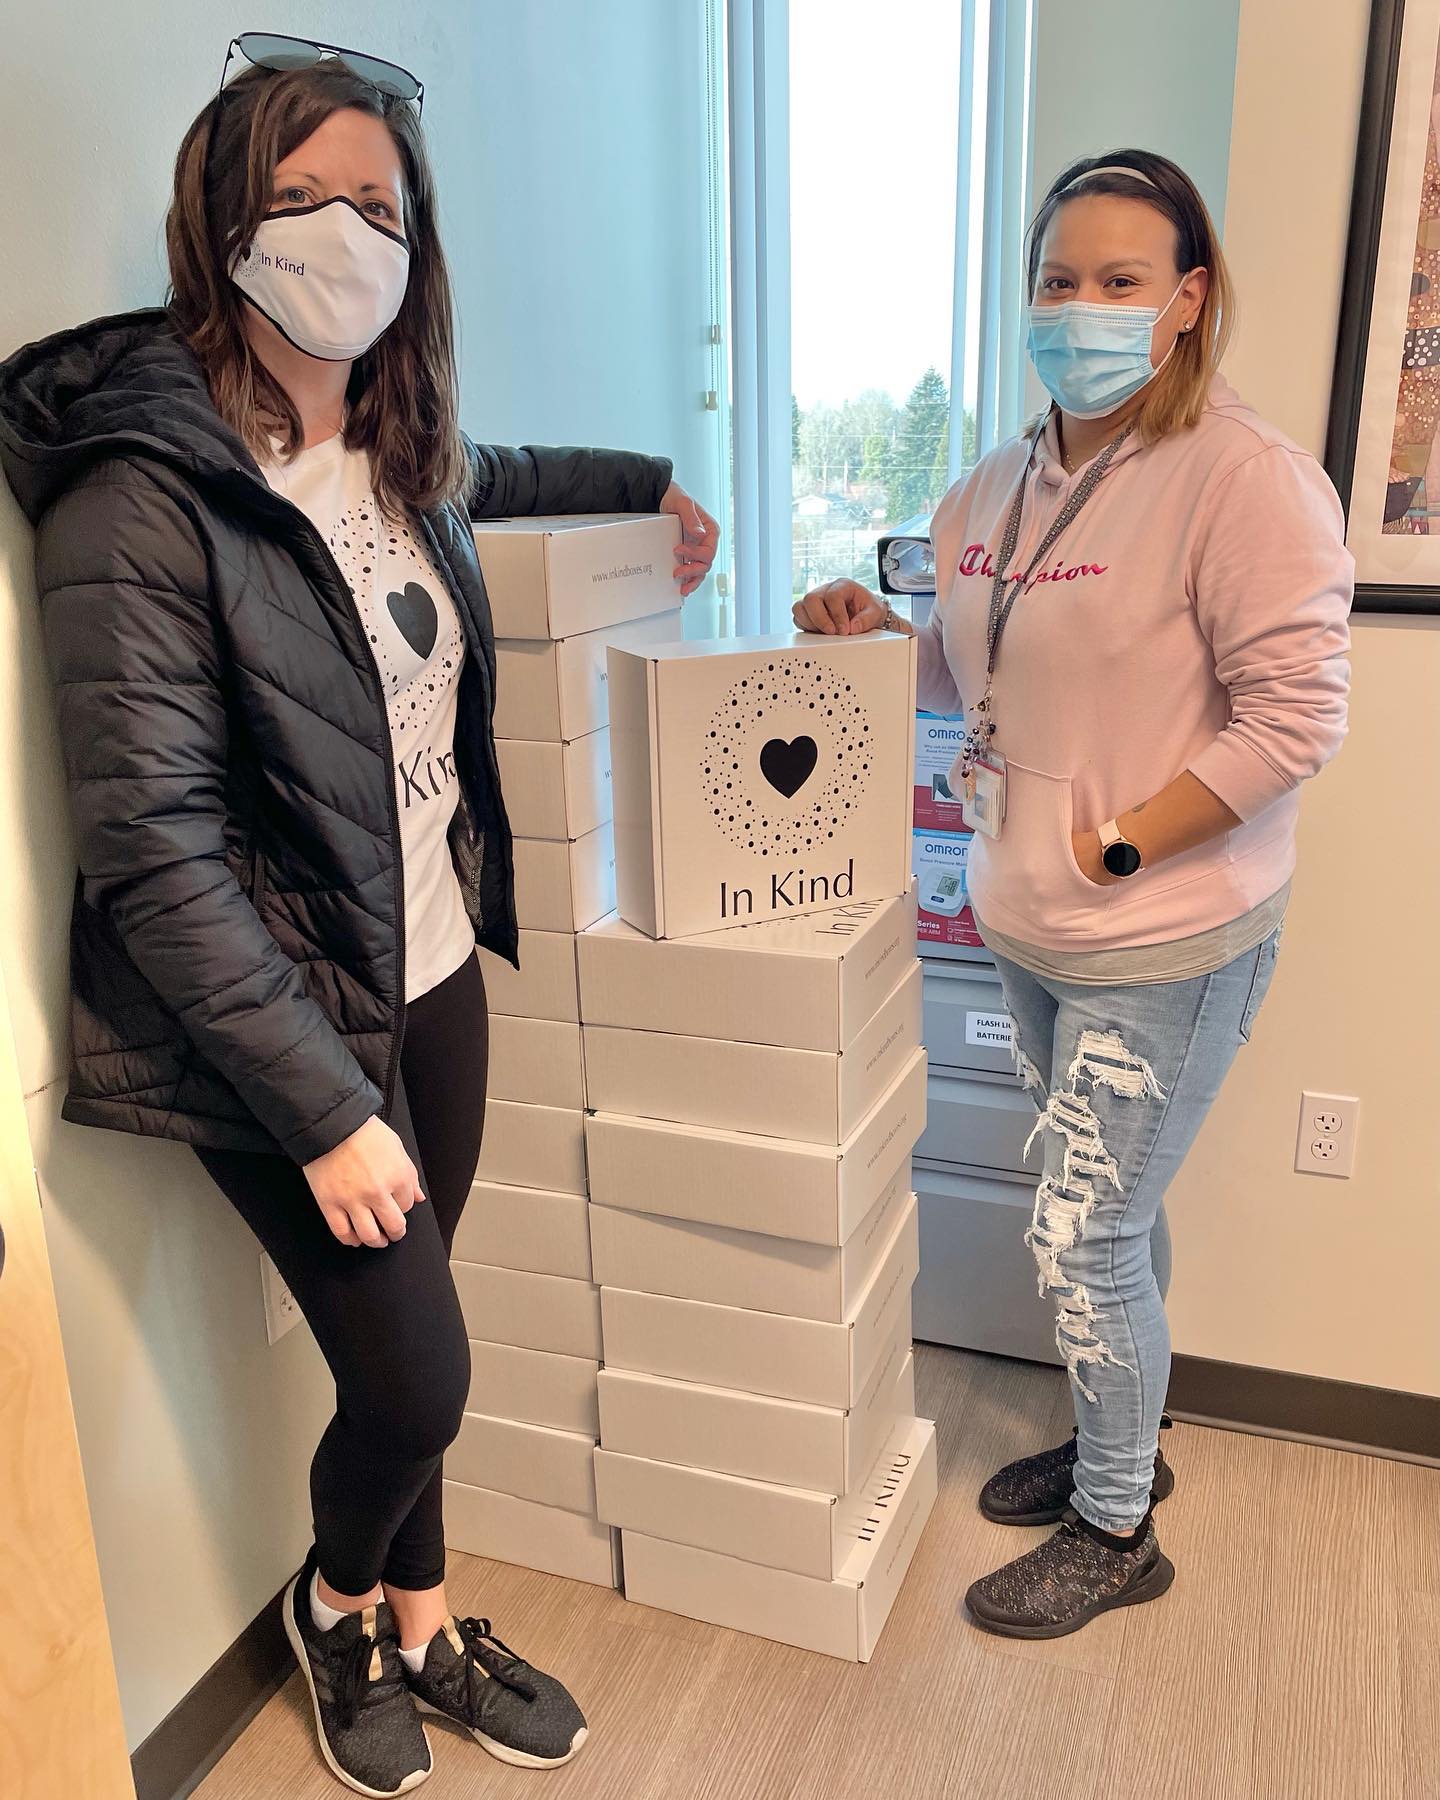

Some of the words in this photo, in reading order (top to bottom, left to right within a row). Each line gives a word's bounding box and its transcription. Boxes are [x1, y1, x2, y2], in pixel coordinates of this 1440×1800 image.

[261, 252, 271, 267] In
[275, 256, 305, 276] Kind
[959, 543, 1109, 595] Chmpion
[928, 728, 966, 741] OMRO
[398, 745, 456, 809] Kin
[720, 881, 753, 918] In
[771, 858, 854, 910] Kind
[815, 922, 860, 936] In
[917, 920, 941, 929] Series
[976, 1019, 1000, 1028] FLASH
[976, 1031, 1012, 1042] BATTERIE
